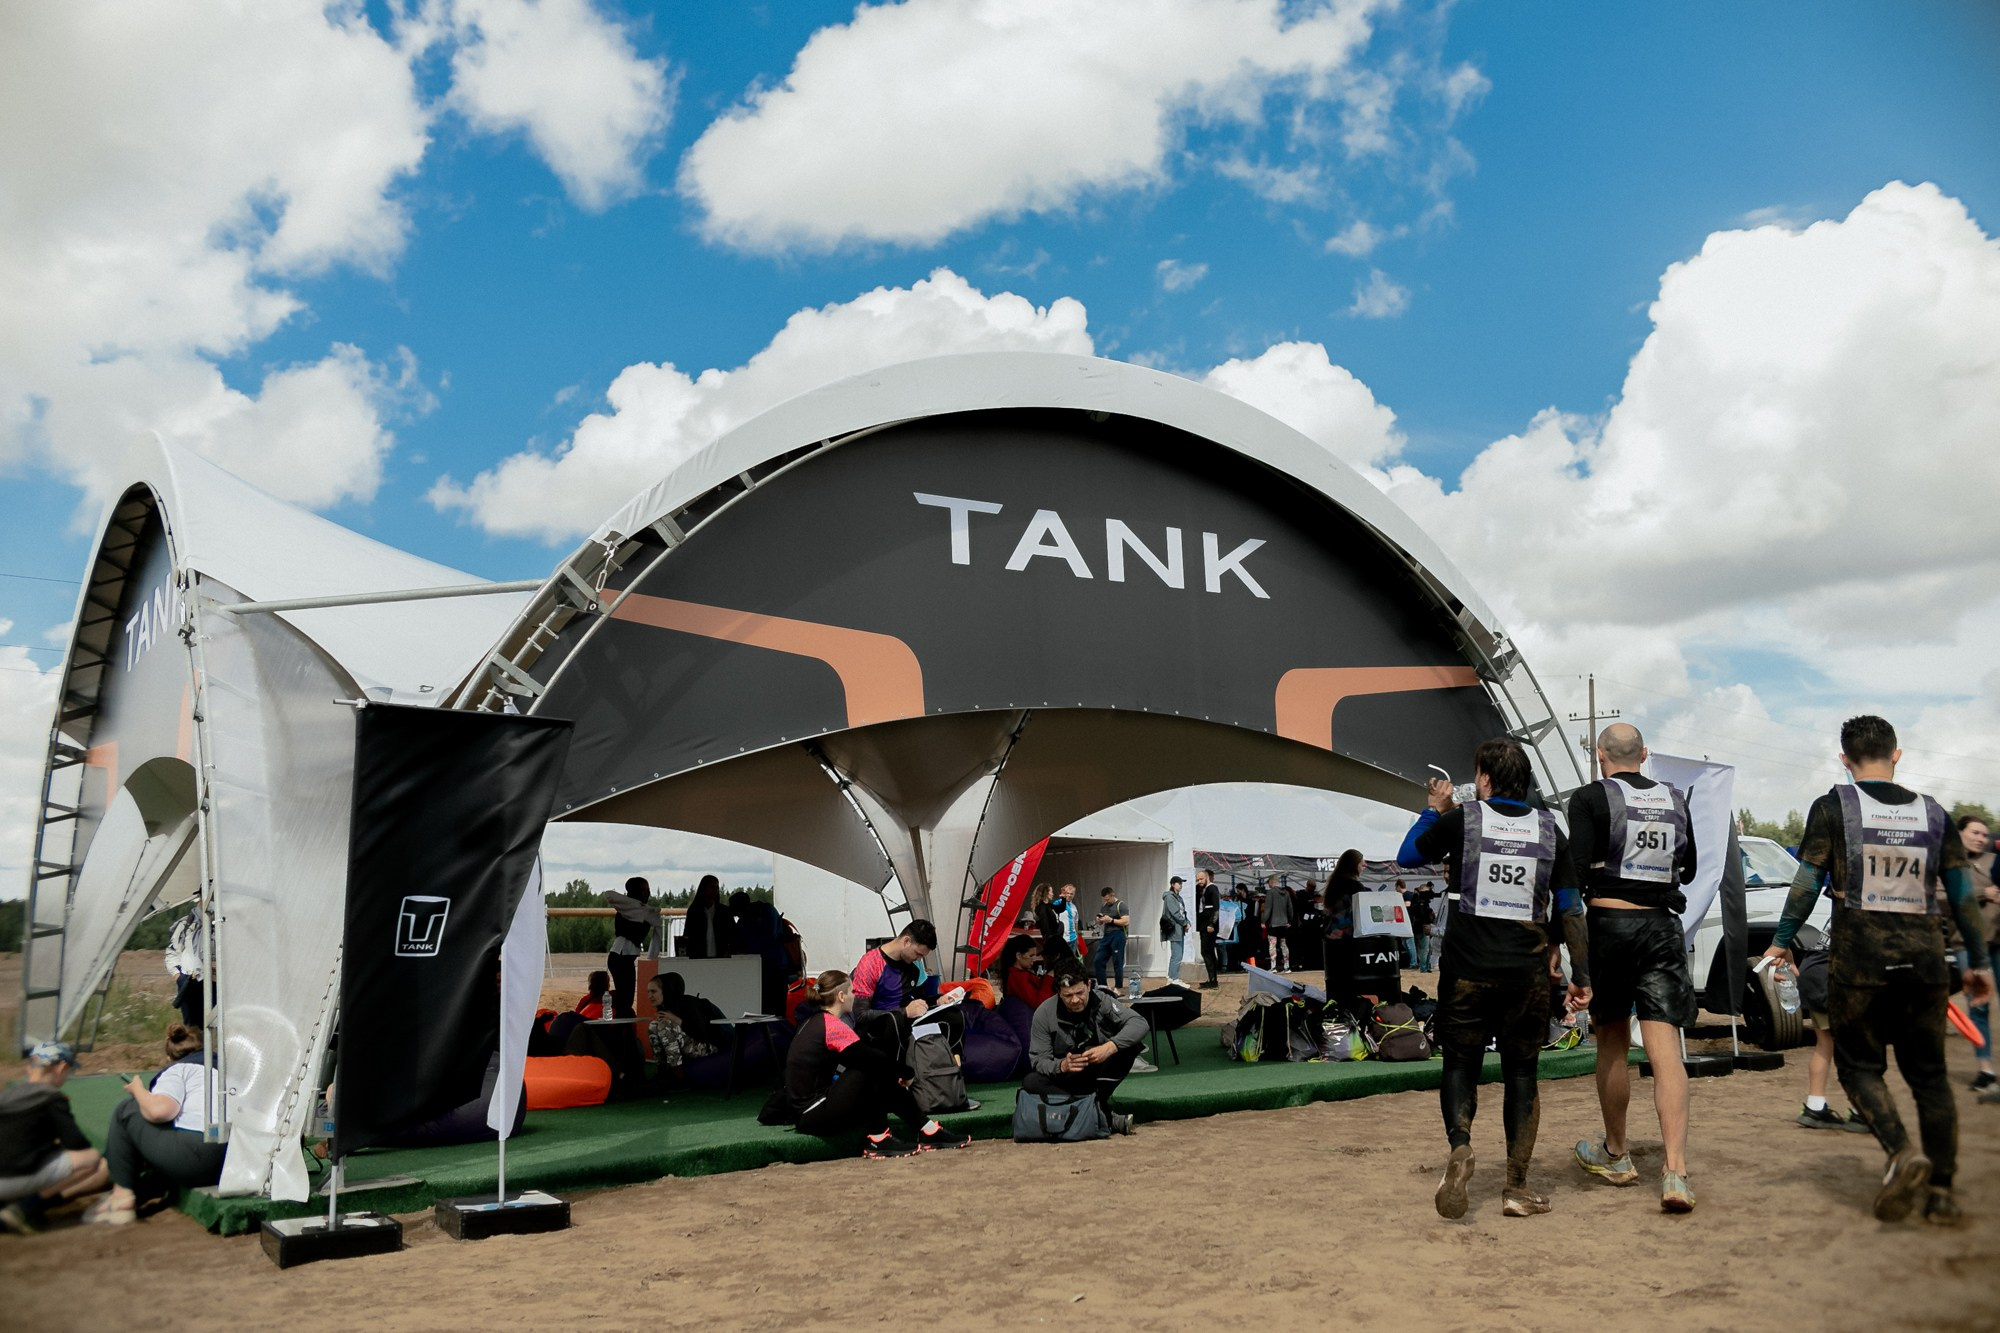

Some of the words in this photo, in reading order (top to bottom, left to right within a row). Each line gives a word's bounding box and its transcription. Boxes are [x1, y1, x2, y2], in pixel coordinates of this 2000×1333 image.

[913, 491, 1271, 599] TANK
[1635, 831, 1667, 850] 951
[1877, 830, 1915, 838] МАССОВЫЙ
[1488, 863, 1526, 886] 952
[1868, 856, 1920, 879] 1174
[1492, 899, 1530, 910] ГАЗПРОМБАНК
[402, 943, 434, 951] TANK
[1360, 950, 1400, 965] TAN
